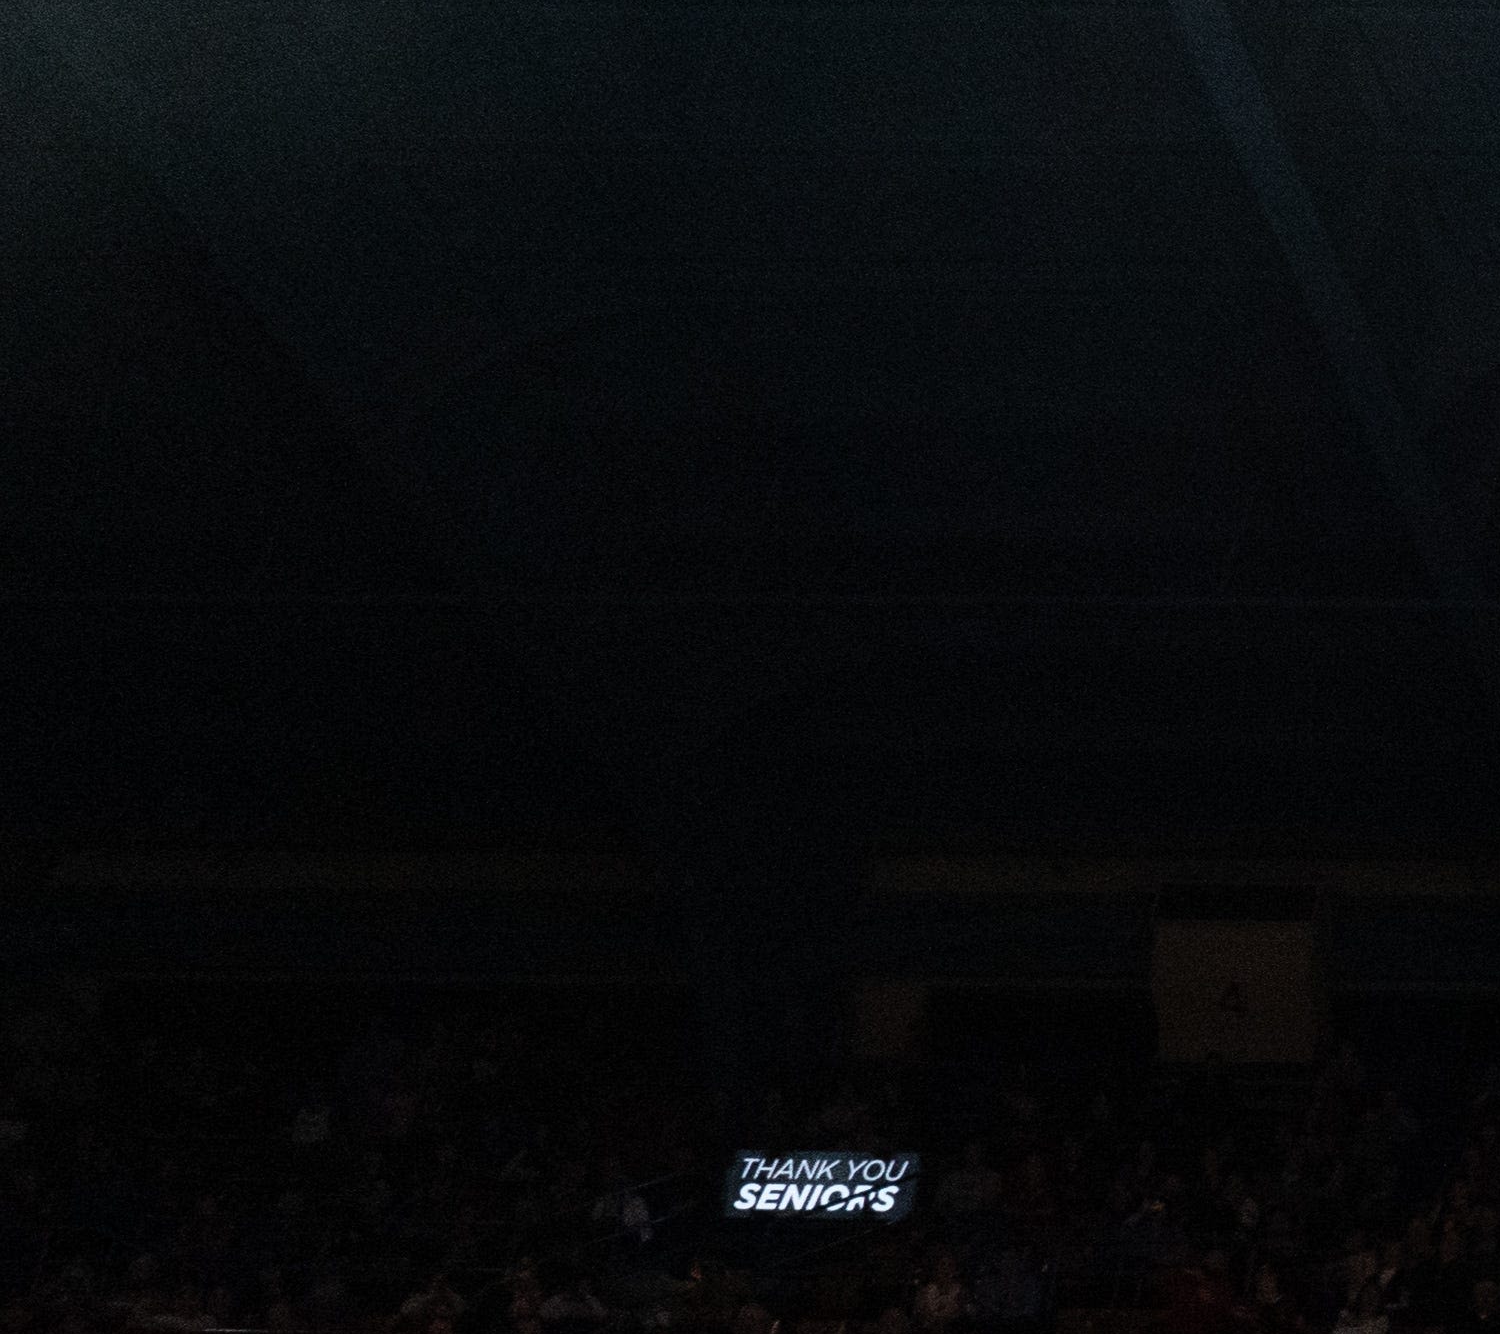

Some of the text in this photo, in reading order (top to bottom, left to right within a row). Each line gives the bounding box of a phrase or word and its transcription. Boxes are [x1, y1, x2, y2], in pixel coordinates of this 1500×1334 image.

[741, 1157, 910, 1182] THANK YOU
[733, 1183, 900, 1212] SENIORS
